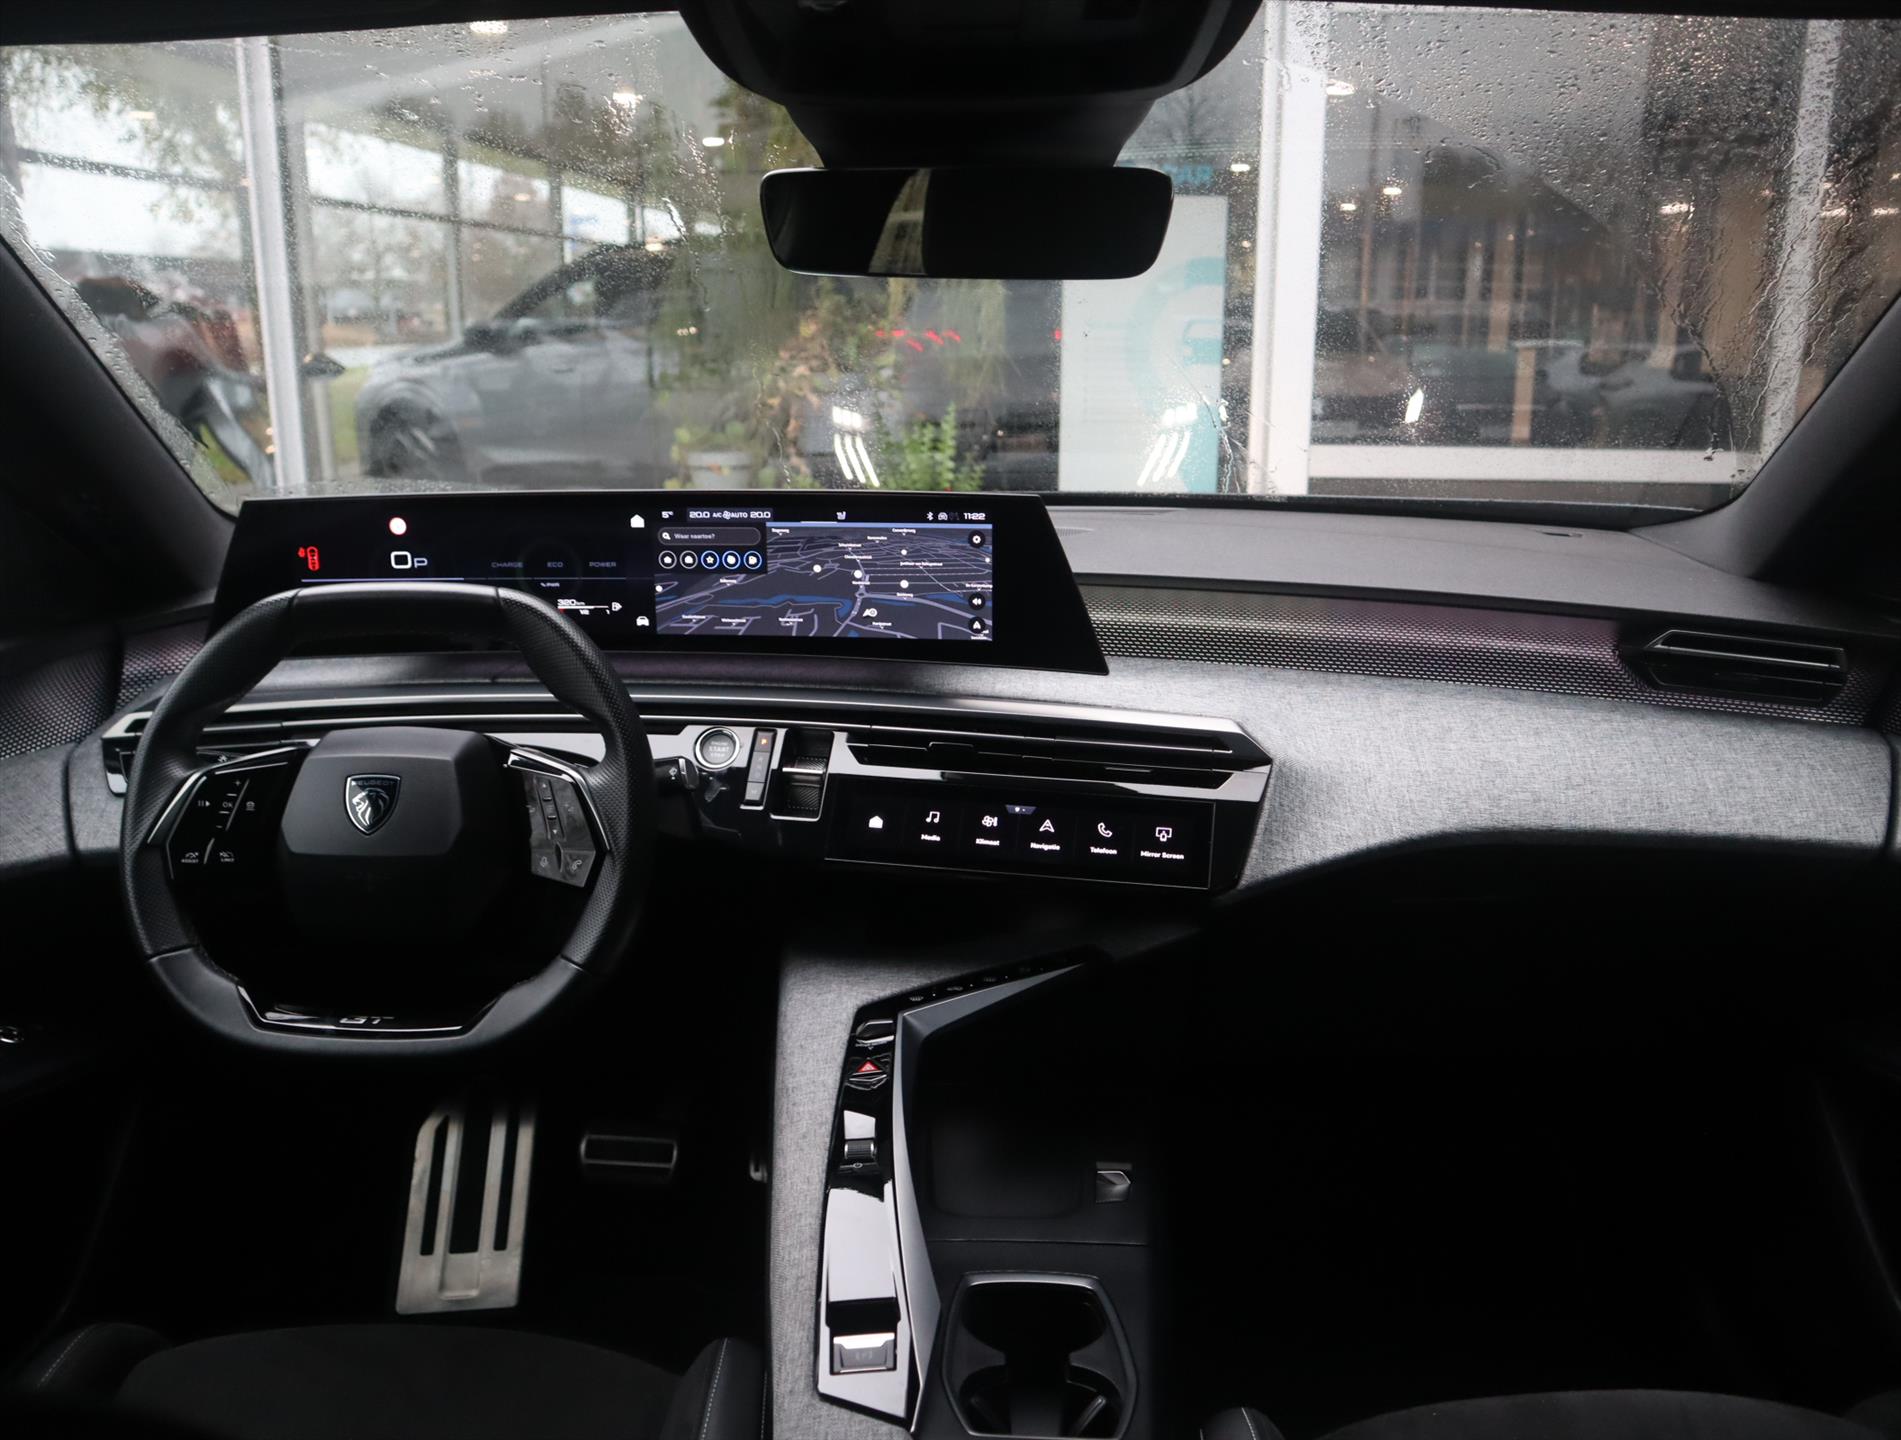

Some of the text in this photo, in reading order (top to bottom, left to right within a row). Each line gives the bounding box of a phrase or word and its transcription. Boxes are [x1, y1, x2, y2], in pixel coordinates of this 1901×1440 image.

[731, 511, 749, 519] AUTO
[749, 511, 772, 519] 20.0
[963, 512, 987, 521] 11:22
[413, 558, 428, 569] P
[921, 834, 941, 842] Media
[976, 838, 1000, 847] Klimaat
[1030, 842, 1061, 851] Navigatie
[1090, 846, 1118, 855] Telefoon
[1140, 850, 1185, 860] Mirror Screen
